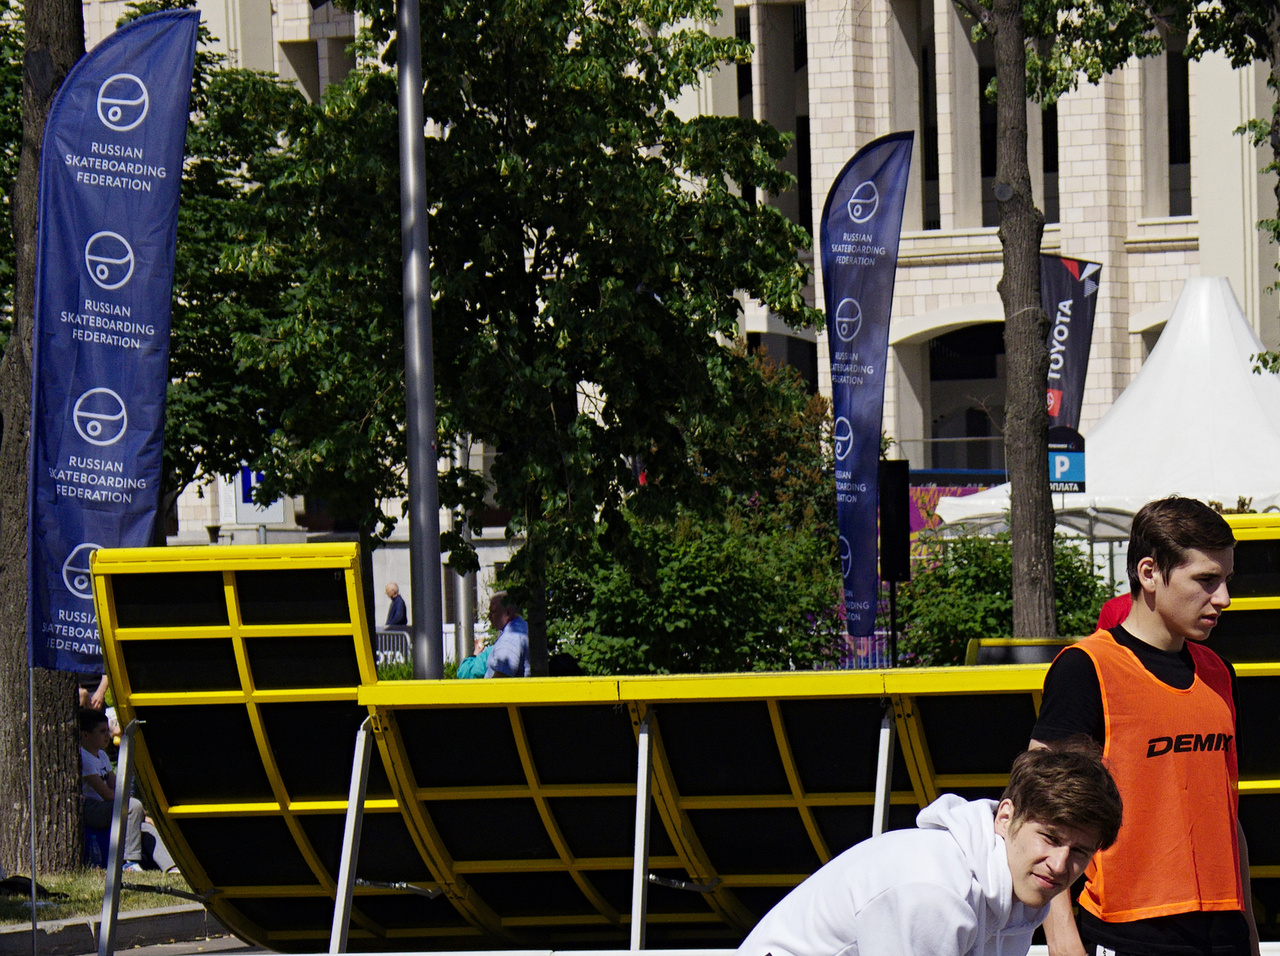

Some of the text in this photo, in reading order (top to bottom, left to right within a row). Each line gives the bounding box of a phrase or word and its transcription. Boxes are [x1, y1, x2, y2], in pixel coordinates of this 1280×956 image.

[91, 142, 143, 159] RUSSIAN
[65, 154, 167, 179] SKATEBOARDING
[76, 172, 151, 192] FEDERATION
[842, 232, 873, 243] RUSSIAN
[831, 243, 886, 256] SKATEBOARDING
[835, 255, 876, 266] FEDERATION
[85, 299, 131, 317] RUSSIAN
[60, 311, 155, 336] SKATEBOARDING
[72, 329, 141, 350] FEDERATION
[1047, 299, 1073, 380] TOYOTA
[69, 456, 123, 473] RUSSIAN
[1055, 455, 1070, 479] P
[56, 484, 132, 503] FEDERATION
[1146, 733, 1233, 759] DEMIX
